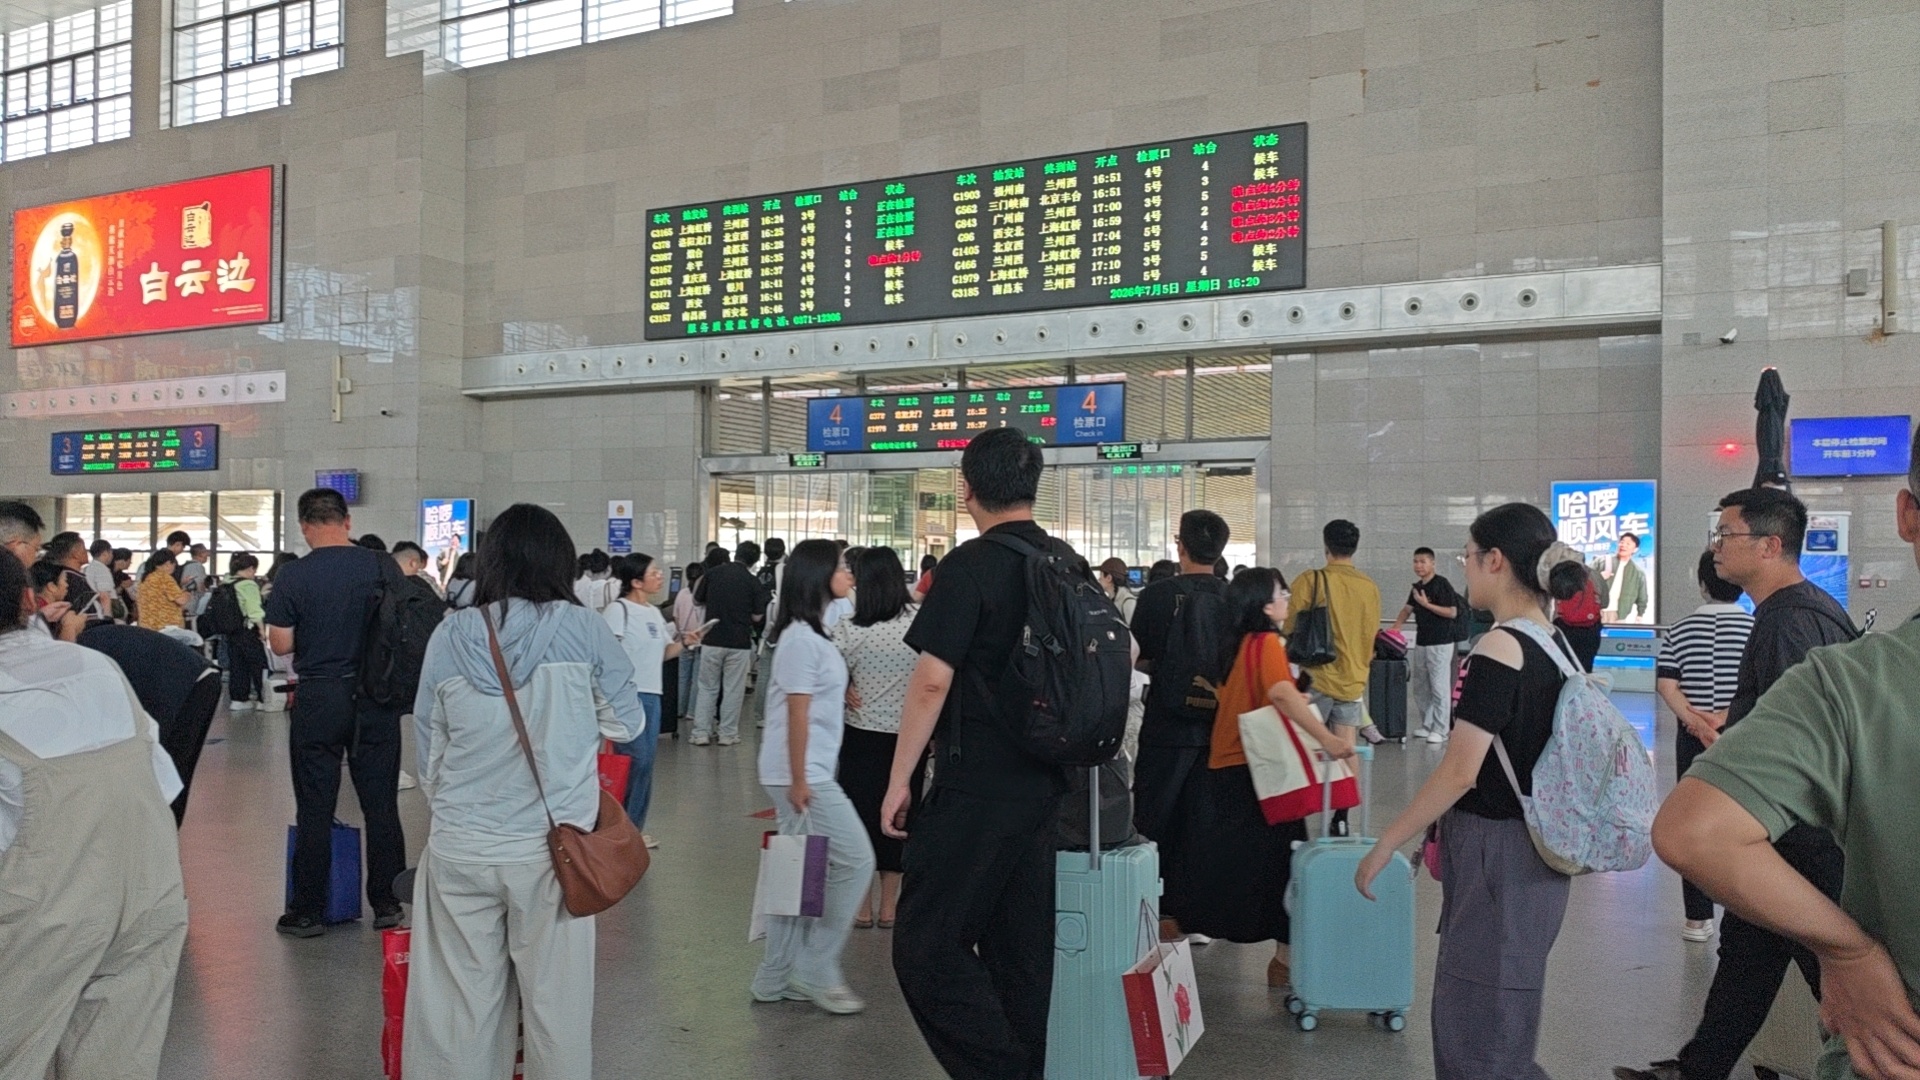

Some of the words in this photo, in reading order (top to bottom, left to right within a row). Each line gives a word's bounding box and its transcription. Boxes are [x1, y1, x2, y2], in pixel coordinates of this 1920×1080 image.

[957, 173, 976, 185] 车次
[993, 167, 1024, 181] 始发站
[1044, 160, 1076, 174] 终到站
[1095, 155, 1117, 168] 开点
[1136, 149, 1170, 162] 检票口
[1193, 141, 1217, 155] 站台
[1253, 133, 1278, 147] 状态
[953, 190, 980, 201] G1903
[994, 183, 1024, 197] 福州南
[1045, 177, 1077, 191] 兰州西
[1093, 173, 1121, 184] 16:51
[1145, 166, 1162, 178] 4号
[1201, 160, 1210, 171] 4
[1254, 151, 1278, 165] 候车
[988, 197, 1029, 211] 三门峡南
[1039, 190, 1081, 205] 北京丰台
[1093, 187, 1121, 199] 16:51
[1145, 181, 1162, 192] 5号
[1201, 175, 1210, 186] 3
[1254, 167, 1278, 180] 候车
[654, 213, 670, 224] 车次
[683, 208, 708, 220] 始发站
[723, 203, 749, 215] 终到站
[763, 199, 781, 210] 开点
[795, 195, 821, 206] 检票口
[839, 189, 858, 201] 站台
[885, 183, 905, 195] 状态
[679, 222, 712, 235] 上海虹桥
[724, 218, 749, 230] 兰州西
[801, 210, 815, 220] 3号
[845, 205, 853, 216] 5
[877, 198, 914, 211] 正在检票
[955, 218, 977, 229] G843
[993, 212, 1024, 225] 广州南
[1044, 205, 1076, 219] 兰州西
[1093, 202, 1122, 213] 17:00
[1144, 195, 1162, 207] 3号
[1200, 190, 1210, 201] 5
[723, 231, 749, 242] 北京西
[801, 223, 815, 233] 4号
[845, 219, 852, 229] 3
[877, 211, 914, 225] 正在检票
[801, 236, 815, 246] 5号
[844, 232, 852, 242] 4
[876, 225, 914, 238] 正在检票
[952, 245, 979, 256] G1405
[993, 240, 1023, 253] 北京西
[1044, 234, 1076, 247] 兰州西
[1093, 230, 1121, 242] 17:04
[1144, 225, 1161, 236] 5号
[1200, 220, 1209, 231] 4
[958, 232, 975, 242] G96
[994, 226, 1024, 239] 西安北
[1039, 219, 1081, 234] 上海虹桥
[1093, 216, 1121, 227] 16:59
[1144, 210, 1161, 222] 4号
[1200, 205, 1209, 217] 2
[723, 256, 748, 267] 兰州西
[801, 249, 815, 259] 3号
[844, 245, 852, 255] 5
[885, 239, 904, 251] 候车
[952, 273, 979, 284] G1979
[987, 267, 1029, 281] 上海虹桥
[1043, 263, 1075, 276] 兰州西
[1092, 260, 1121, 271] 17:10
[1143, 255, 1161, 266] 3号
[1200, 250, 1209, 261] 5
[1253, 243, 1277, 256] 候车
[955, 260, 976, 270] G466
[993, 254, 1023, 267] 兰州西
[1038, 248, 1081, 262] 上海虹桥
[1092, 245, 1121, 256] 17:09
[1144, 240, 1161, 251] 5号
[1199, 235, 1209, 247] 2
[140, 252, 256, 304] 白云边
[678, 285, 711, 297] 上海虹桥
[761, 279, 782, 289] 16:41
[801, 275, 815, 285] 4号
[844, 271, 851, 282] 4
[885, 266, 904, 277] 候车
[719, 268, 752, 280] 上海虹桥
[761, 266, 783, 276] 16:37
[801, 262, 815, 272] 4号
[844, 258, 852, 269] 3
[952, 287, 979, 298] G3185
[992, 282, 1023, 295] 南昌东
[1043, 277, 1075, 290] 兰州西
[1092, 274, 1120, 285] 17:18
[1143, 269, 1161, 281] 5号
[1199, 265, 1208, 276] 4
[1252, 259, 1277, 271] 候车
[723, 294, 748, 305] 北京西
[760, 292, 782, 301] 16:41
[800, 288, 814, 298] 3号
[843, 284, 852, 295] 2
[885, 280, 904, 291] 候车
[800, 301, 814, 311] 3号
[844, 297, 852, 308] 5
[885, 293, 904, 304] 候车
[1110, 283, 1179, 298] 2026年7月5日
[1185, 279, 1220, 292] 星期日
[1228, 277, 1260, 288] 16:20
[829, 404, 843, 425] 4
[1081, 390, 1097, 414] 4
[823, 427, 850, 438] 检票口
[1073, 416, 1106, 428] 检票口
[63, 437, 72, 453] 3
[194, 430, 203, 448] 3
[1101, 444, 1137, 453] 安全出口
[425, 504, 453, 522] 哈啰
[1558, 487, 1619, 518] 哈啰
[425, 520, 465, 541] 顺风车
[1557, 512, 1650, 545] 顺风车
